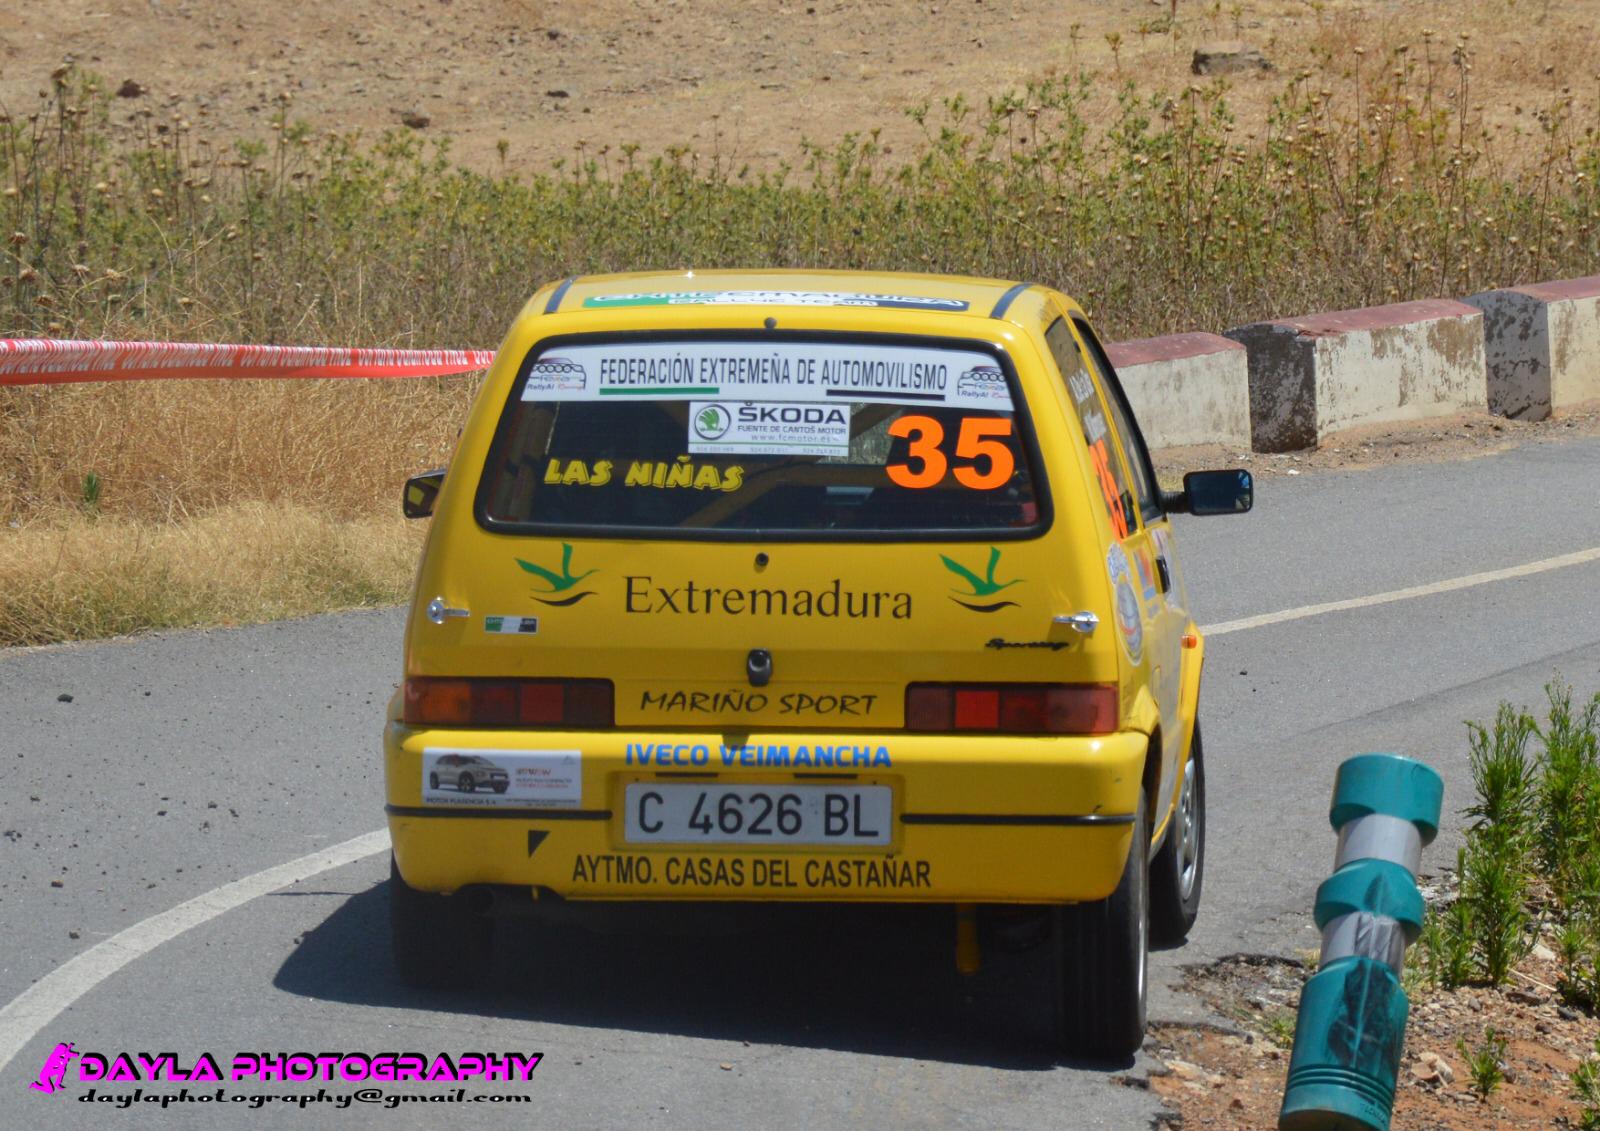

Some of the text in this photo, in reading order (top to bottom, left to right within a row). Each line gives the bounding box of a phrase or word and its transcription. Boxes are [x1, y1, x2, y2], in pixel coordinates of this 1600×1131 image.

[601, 353, 946, 390] FEDERACIÓN EXTREMEÑA DE AUTOMOVILISMO
[738, 425, 767, 433] FUENTE
[885, 415, 1015, 490] 35
[543, 455, 744, 493] LAS NIÑAS
[623, 575, 912, 619] Extremadura
[641, 690, 877, 715] MARIÑO SPORT
[625, 744, 892, 768] IVECO VEIMANCHA
[639, 791, 879, 837] C 4626 BL
[572, 854, 931, 889] AYTMO. CASAS DEL CASTAÑAR
